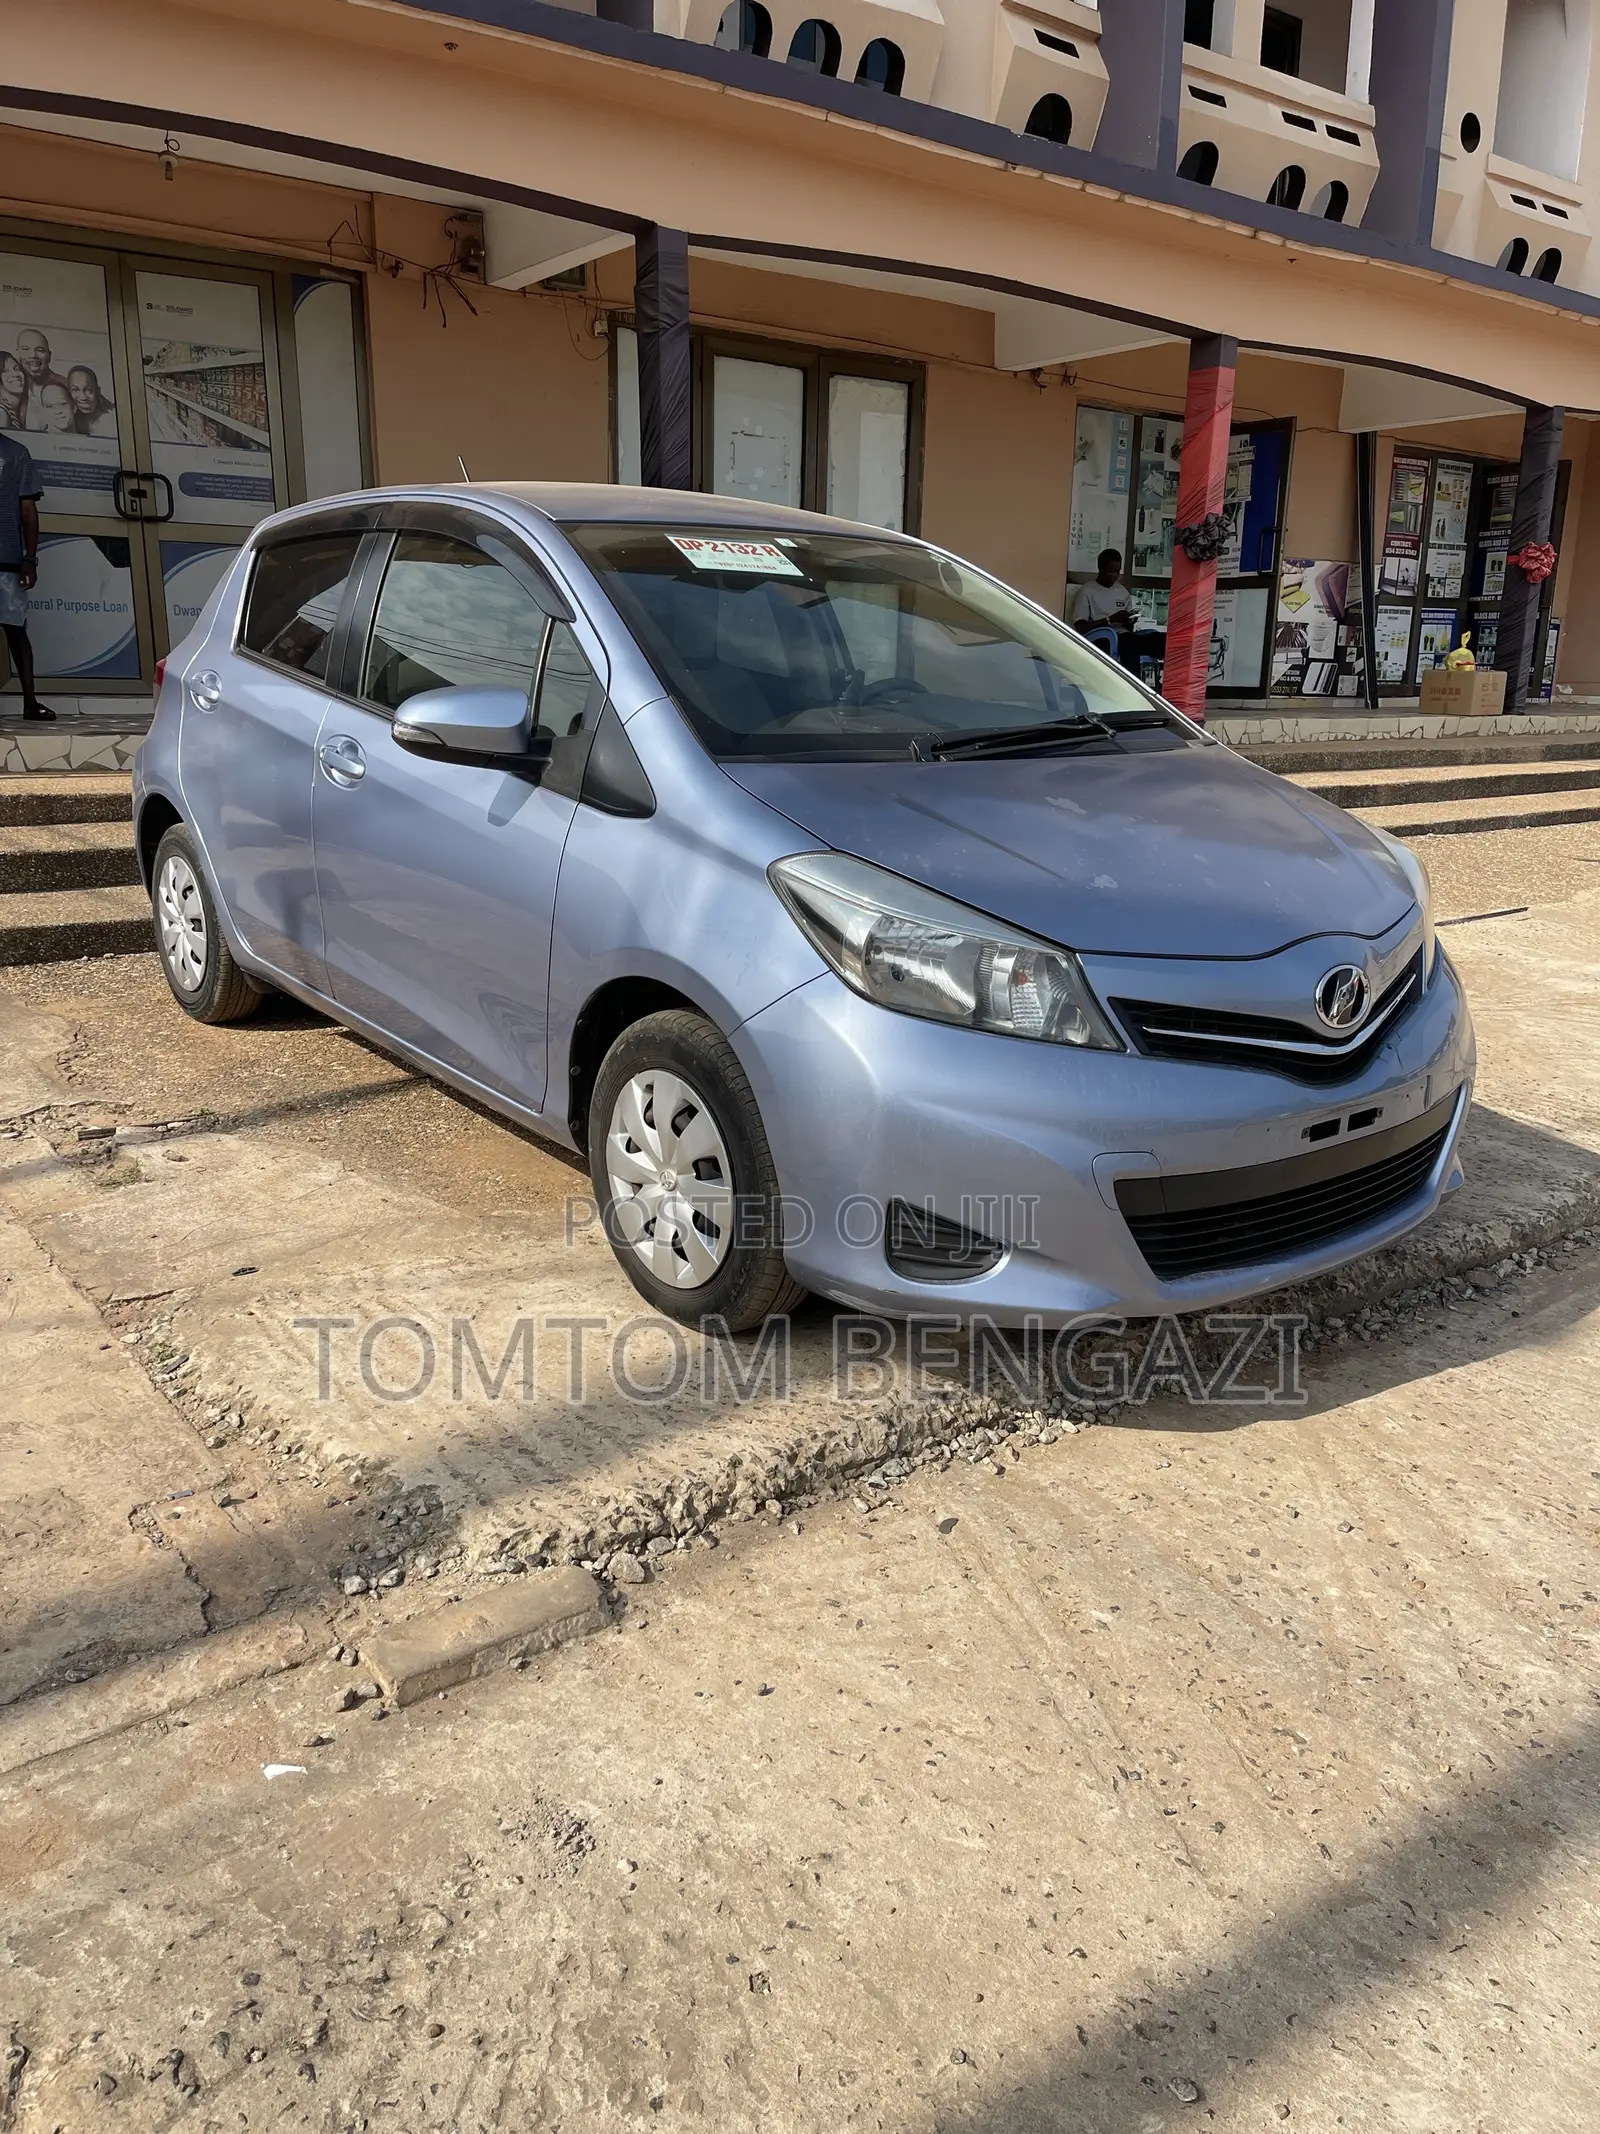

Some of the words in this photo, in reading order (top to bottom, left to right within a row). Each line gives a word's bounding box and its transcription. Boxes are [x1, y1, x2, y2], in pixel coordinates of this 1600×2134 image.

[27, 598, 53, 611] neral
[56, 598, 101, 614] Purpose
[103, 602, 128, 613] Loan
[173, 604, 202, 619] Dwap
